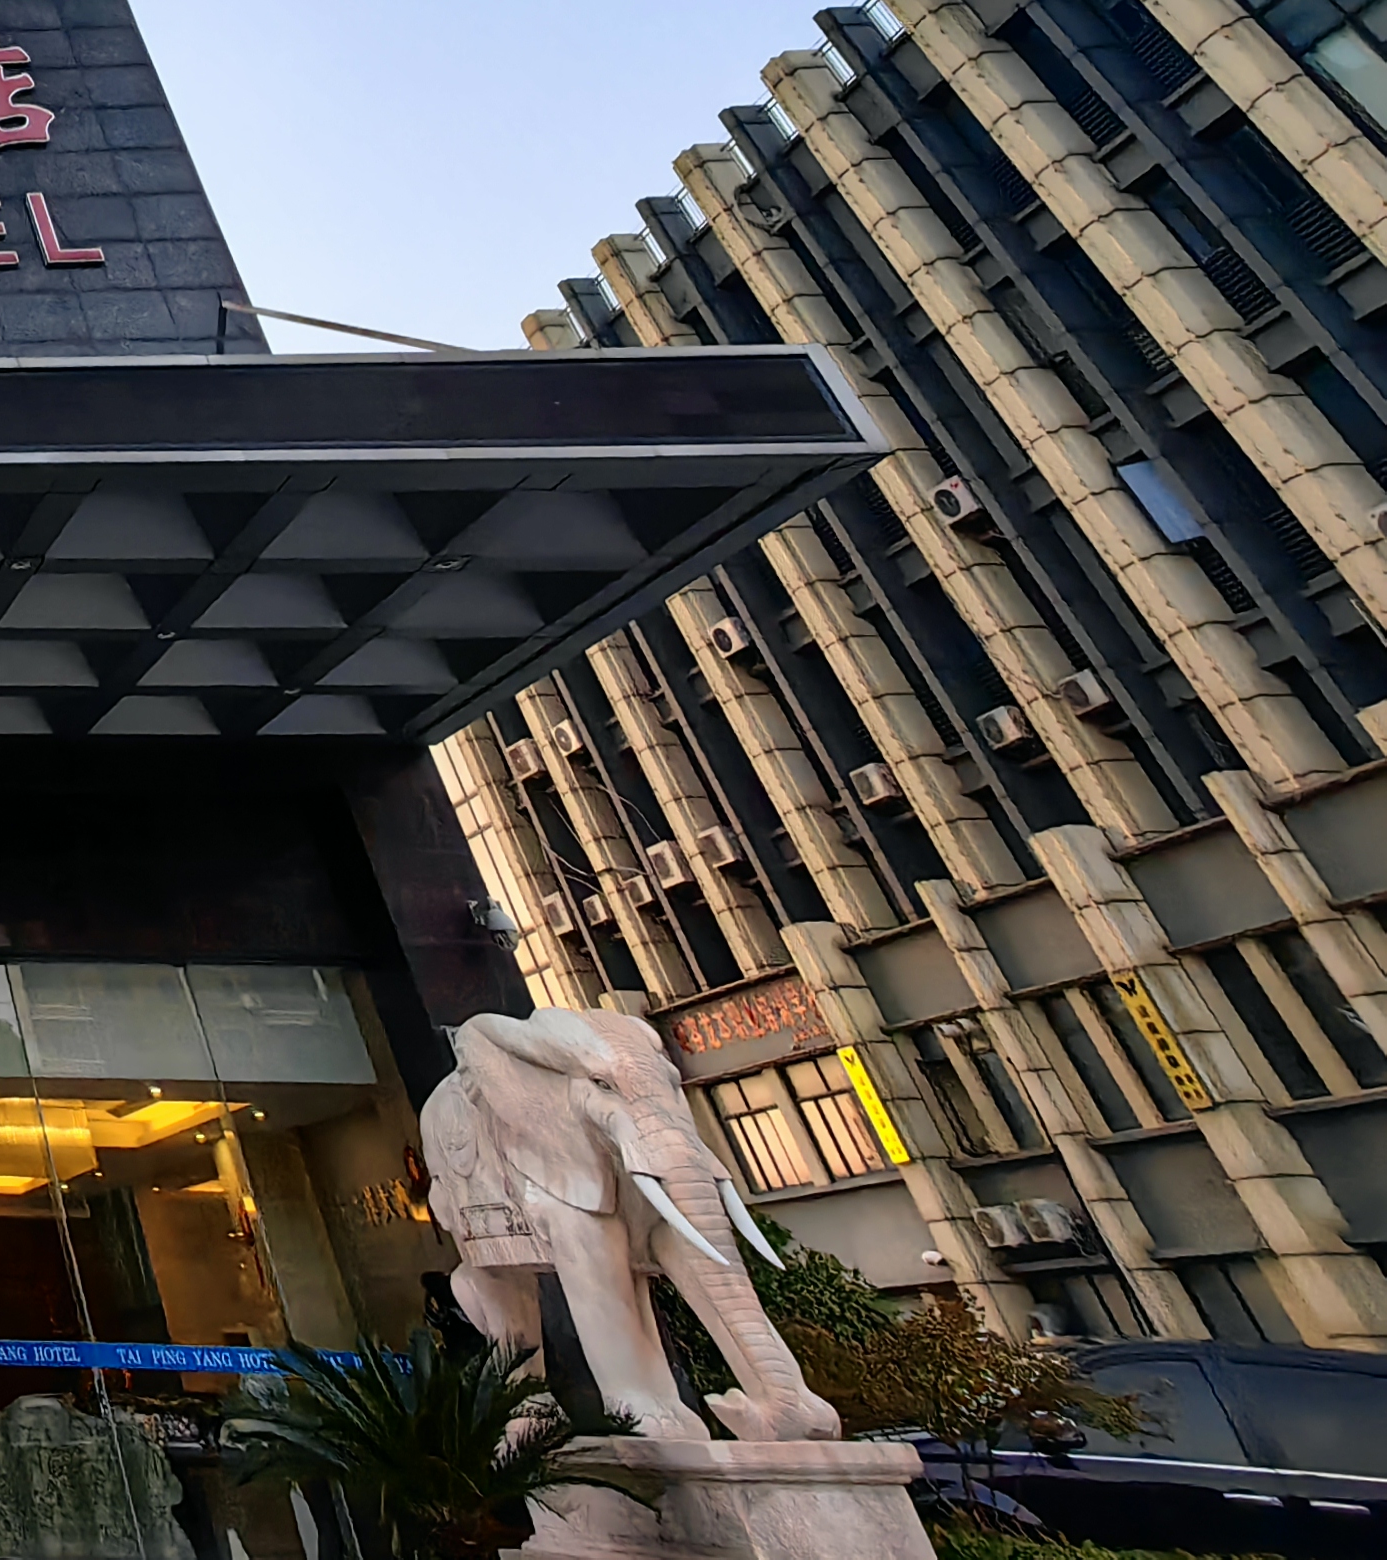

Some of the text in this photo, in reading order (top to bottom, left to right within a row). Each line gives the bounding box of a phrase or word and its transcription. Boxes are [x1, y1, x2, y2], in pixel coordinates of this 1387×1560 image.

[34, 1343, 81, 1363] HOTEL
[116, 1347, 142, 1365] TAI
[152, 1348, 186, 1367] PING
[192, 1350, 232, 1368] YANG
